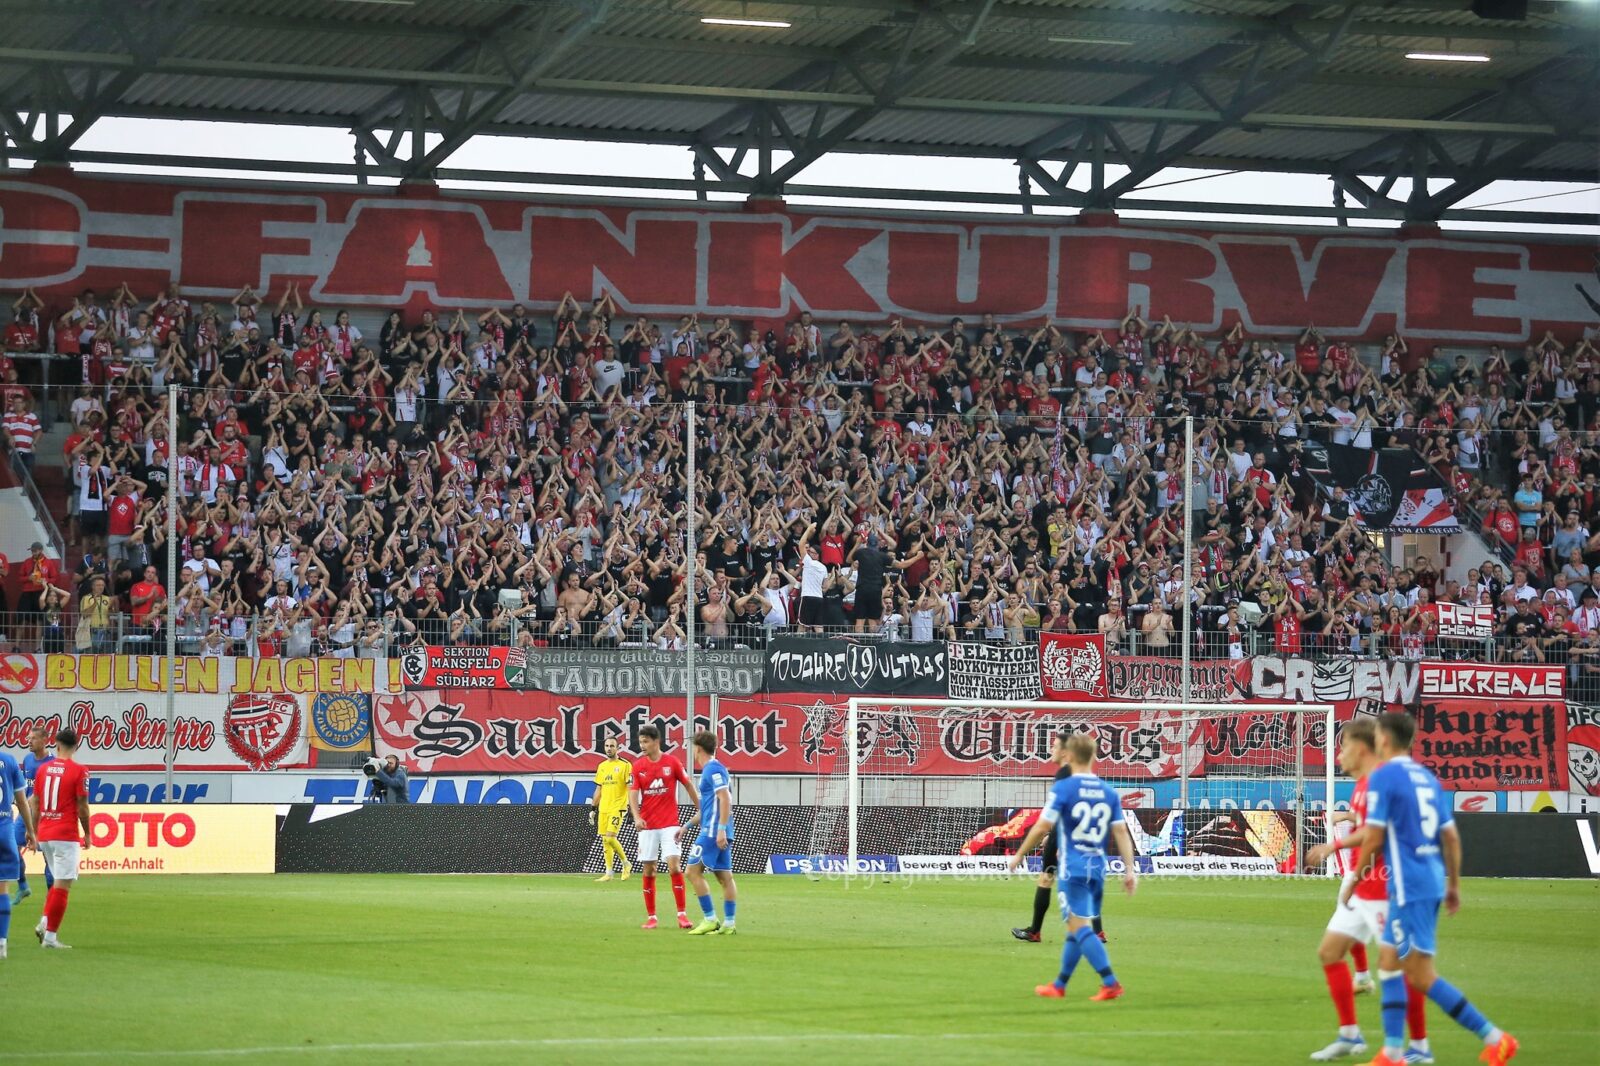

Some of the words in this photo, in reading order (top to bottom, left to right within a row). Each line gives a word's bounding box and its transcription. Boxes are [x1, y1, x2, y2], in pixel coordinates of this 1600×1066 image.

[174, 190, 1531, 342] FANKURVE
[1438, 604, 1492, 626] HFC
[443, 647, 490, 657] SEKTION
[950, 641, 1039, 662] TELEKOM
[45, 653, 219, 693] BULLEN
[231, 656, 376, 693] JAGEN
[431, 657, 501, 669] MANSFELD
[878, 651, 945, 682] ULTRAS
[949, 658, 1039, 677] BOYKOTTIEREN
[436, 672, 495, 687] SÜDHARZ
[949, 672, 1040, 689] MONTAGSSPIELE
[1107, 660, 1229, 695] Pyromnie
[1422, 668, 1562, 696] SURREALE
[950, 684, 978, 698] NICHT
[979, 687, 1042, 701] AKZEPTIEREN
[1151, 682, 1228, 700] Leidschaft
[68, 700, 118, 751] Per
[118, 702, 216, 763] Sempre
[44, 775, 61, 811] 11
[611, 816, 620, 826] 23
[1071, 801, 1112, 843] 23
[1415, 786, 1439, 839] 5
[79, 857, 164, 870] chsen-Anhalt
[784, 859, 814, 872] PS
[820, 859, 887, 872] UNON
[903, 860, 952, 871] bewegt
[956, 860, 977, 870] die
[979, 861, 1026, 871] Regin
[1156, 861, 1206, 872] bewegt
[1209, 861, 1228, 871] die
[1230, 861, 1275, 873] Region
[1391, 919, 1405, 943] 5
